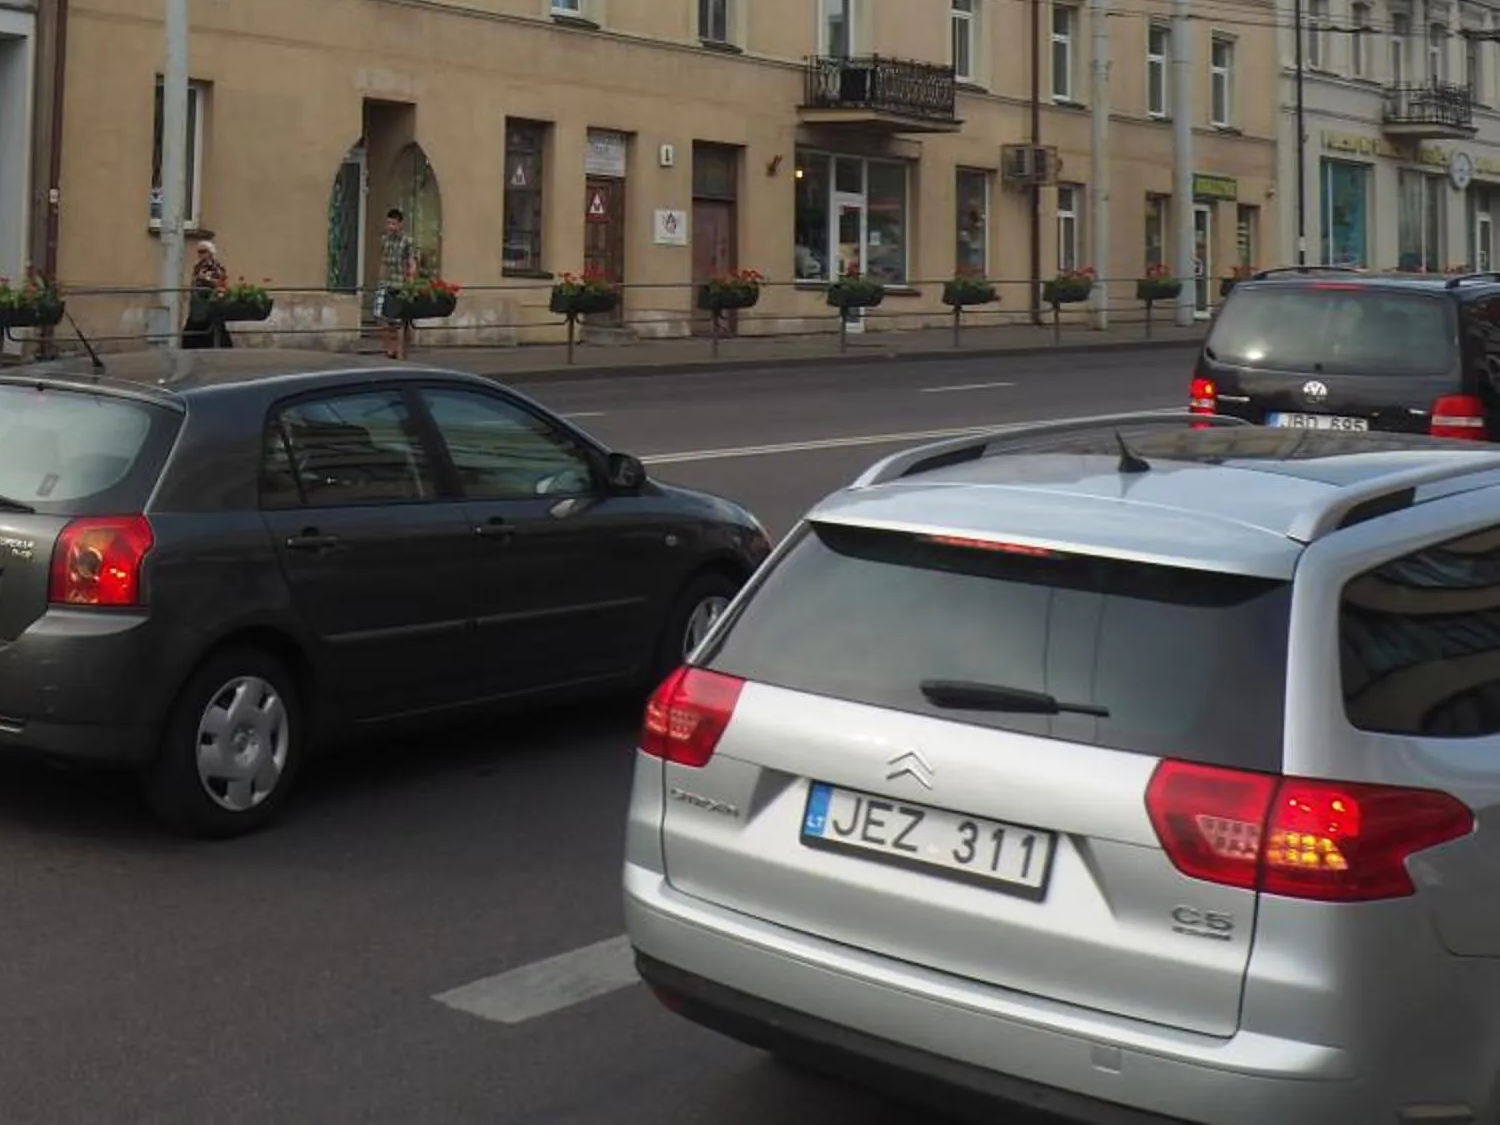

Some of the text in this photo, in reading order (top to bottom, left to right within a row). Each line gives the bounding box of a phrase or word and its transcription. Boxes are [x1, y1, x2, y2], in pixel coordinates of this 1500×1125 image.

[832, 797, 1036, 878] JEZ 311
[1171, 906, 1235, 930] C5
